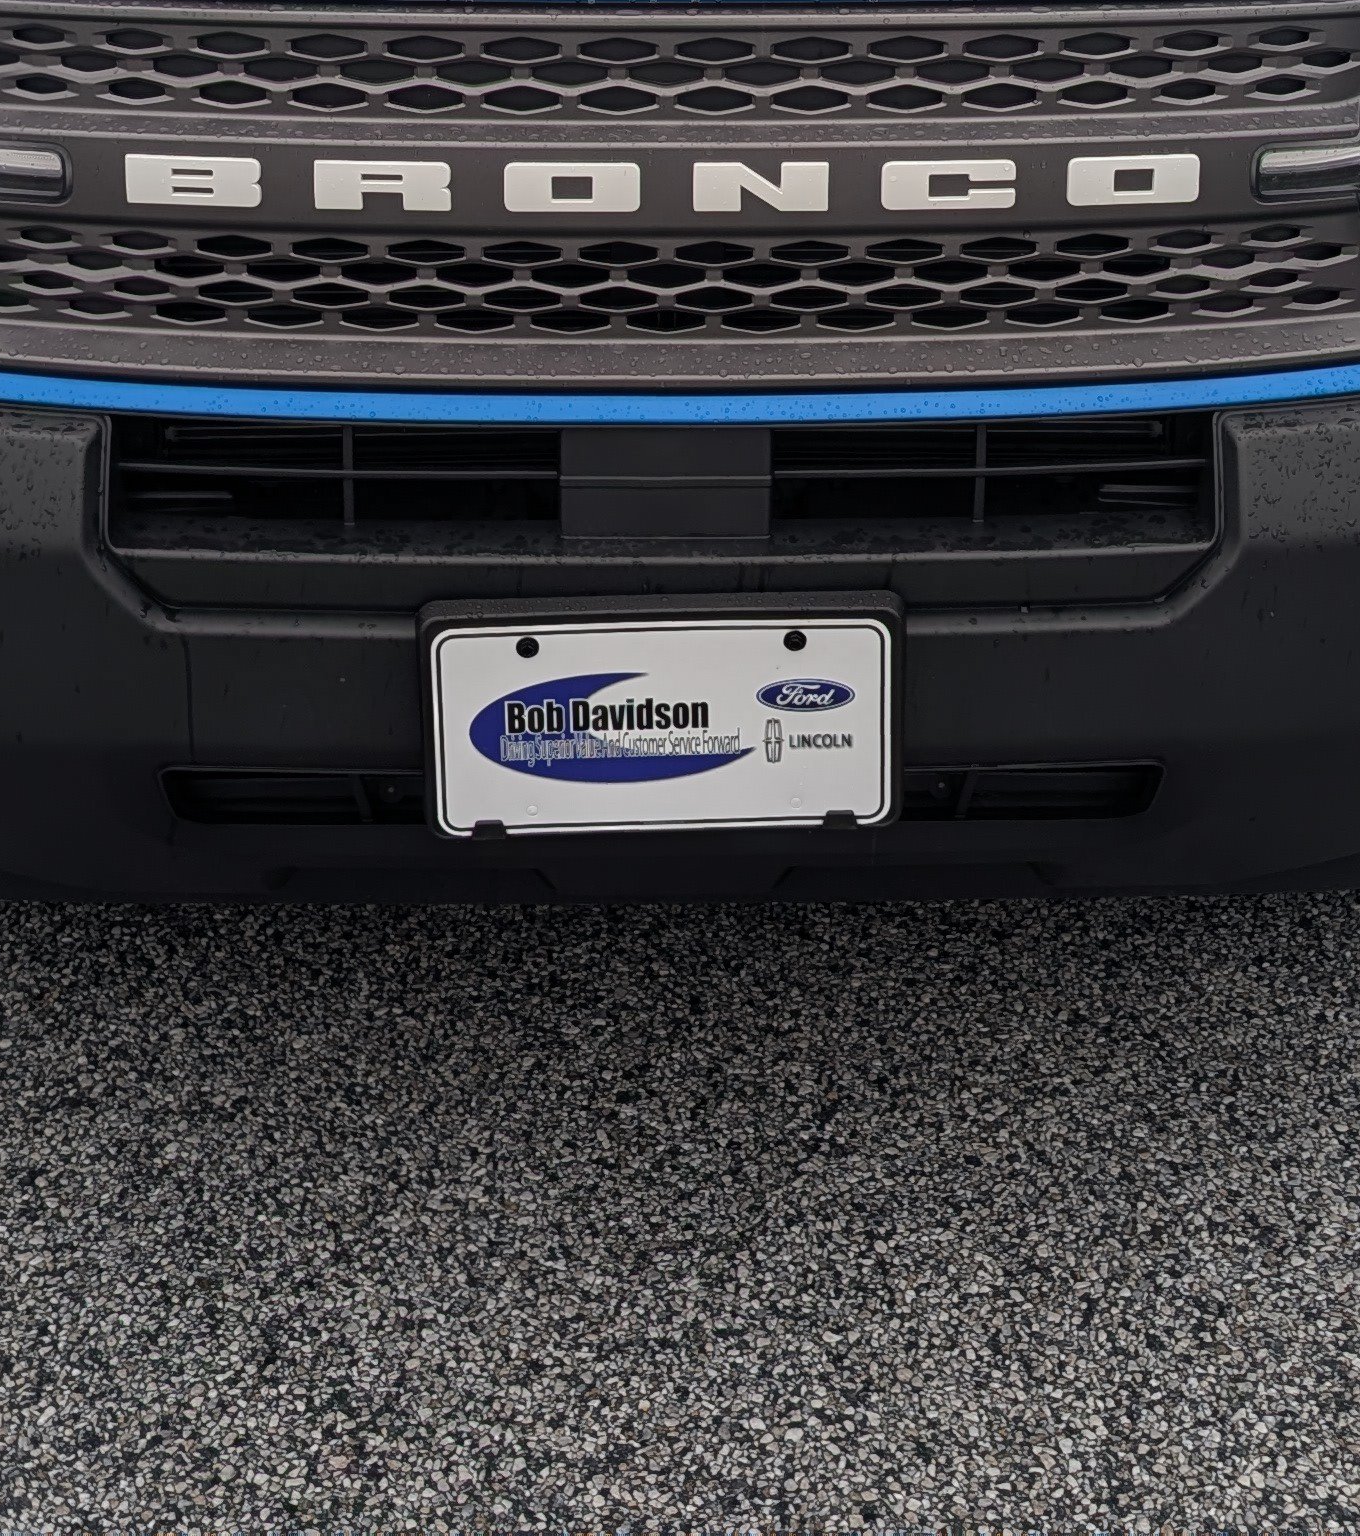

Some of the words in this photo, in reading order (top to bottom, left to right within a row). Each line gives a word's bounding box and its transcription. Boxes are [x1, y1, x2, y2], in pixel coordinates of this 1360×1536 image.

[124, 154, 1201, 212] BRONCO
[776, 682, 836, 706] Ford
[506, 699, 566, 735] Bob
[569, 698, 710, 733] Davidson
[501, 734, 535, 767] Driving
[535, 733, 575, 767] Superior
[575, 733, 602, 759] Value
[602, 732, 622, 758] And
[622, 731, 667, 757] Customer
[667, 730, 701, 755] Service
[702, 727, 741, 755] Forward
[788, 733, 853, 748] LINCOLN
